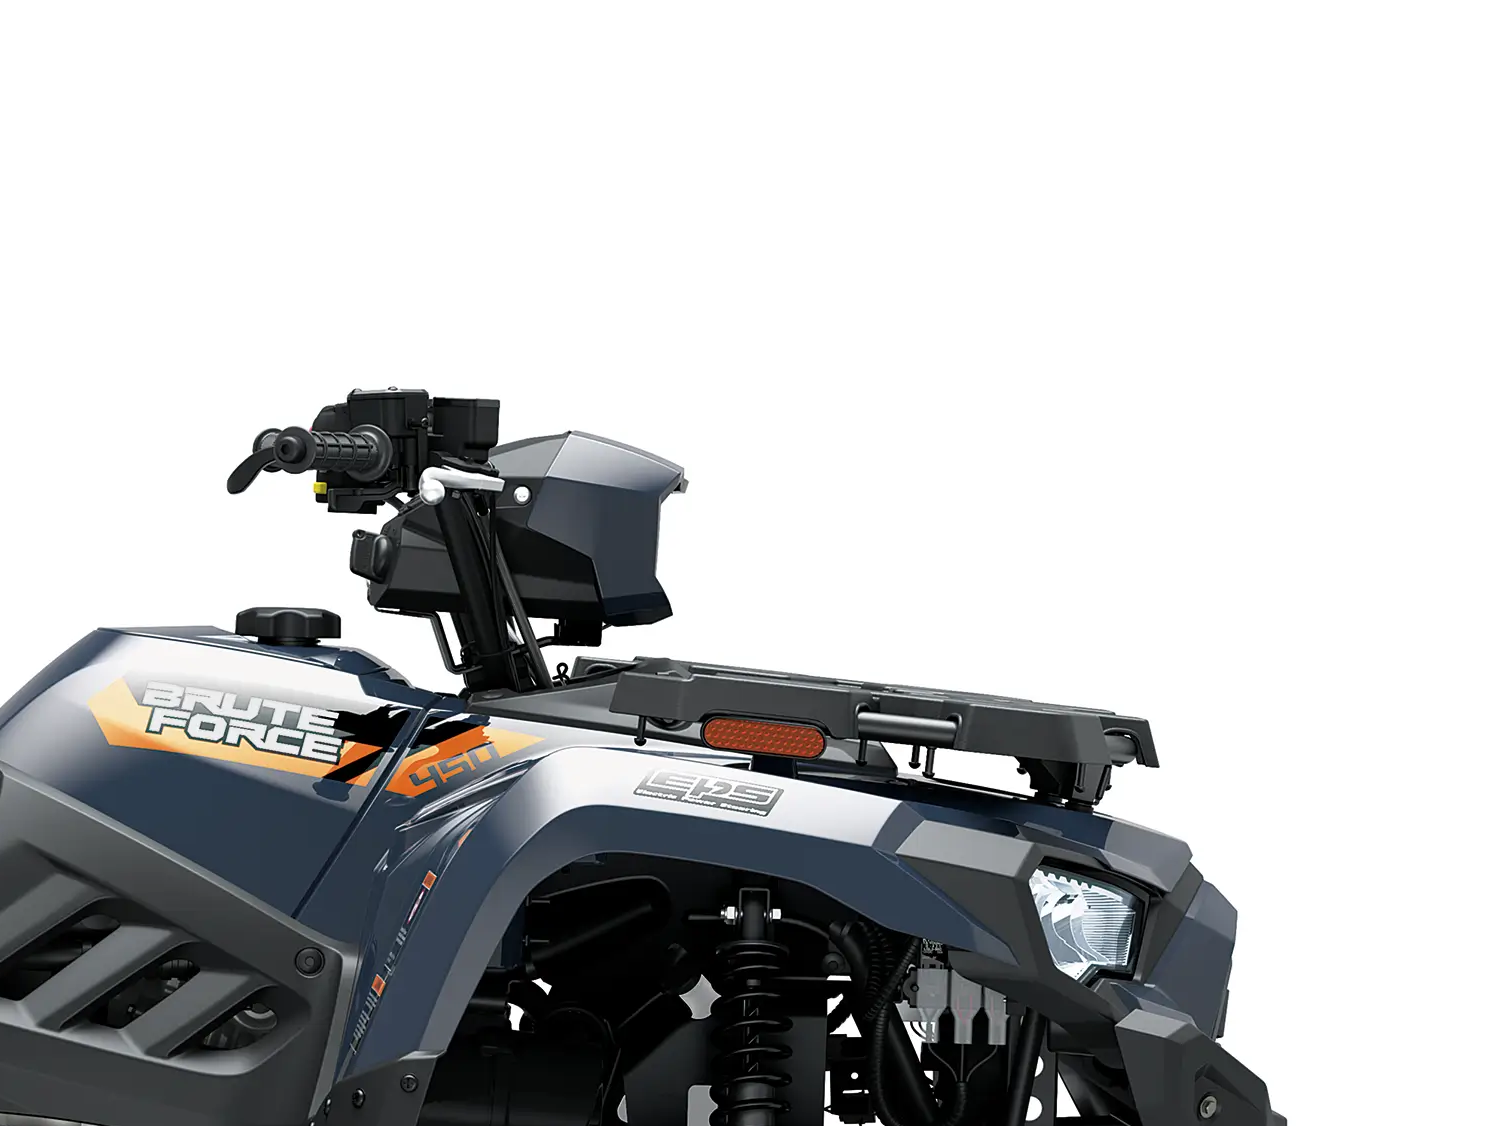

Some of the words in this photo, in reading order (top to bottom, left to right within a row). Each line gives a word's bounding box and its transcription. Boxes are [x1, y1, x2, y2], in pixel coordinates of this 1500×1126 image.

[143, 682, 340, 733] BRUTE
[145, 706, 344, 766] FORCE
[408, 742, 504, 790] 450
[647, 769, 777, 806] EPS
[635, 788, 678, 801] Electric
[681, 795, 717, 807] Power
[719, 802, 768, 816] Steering
